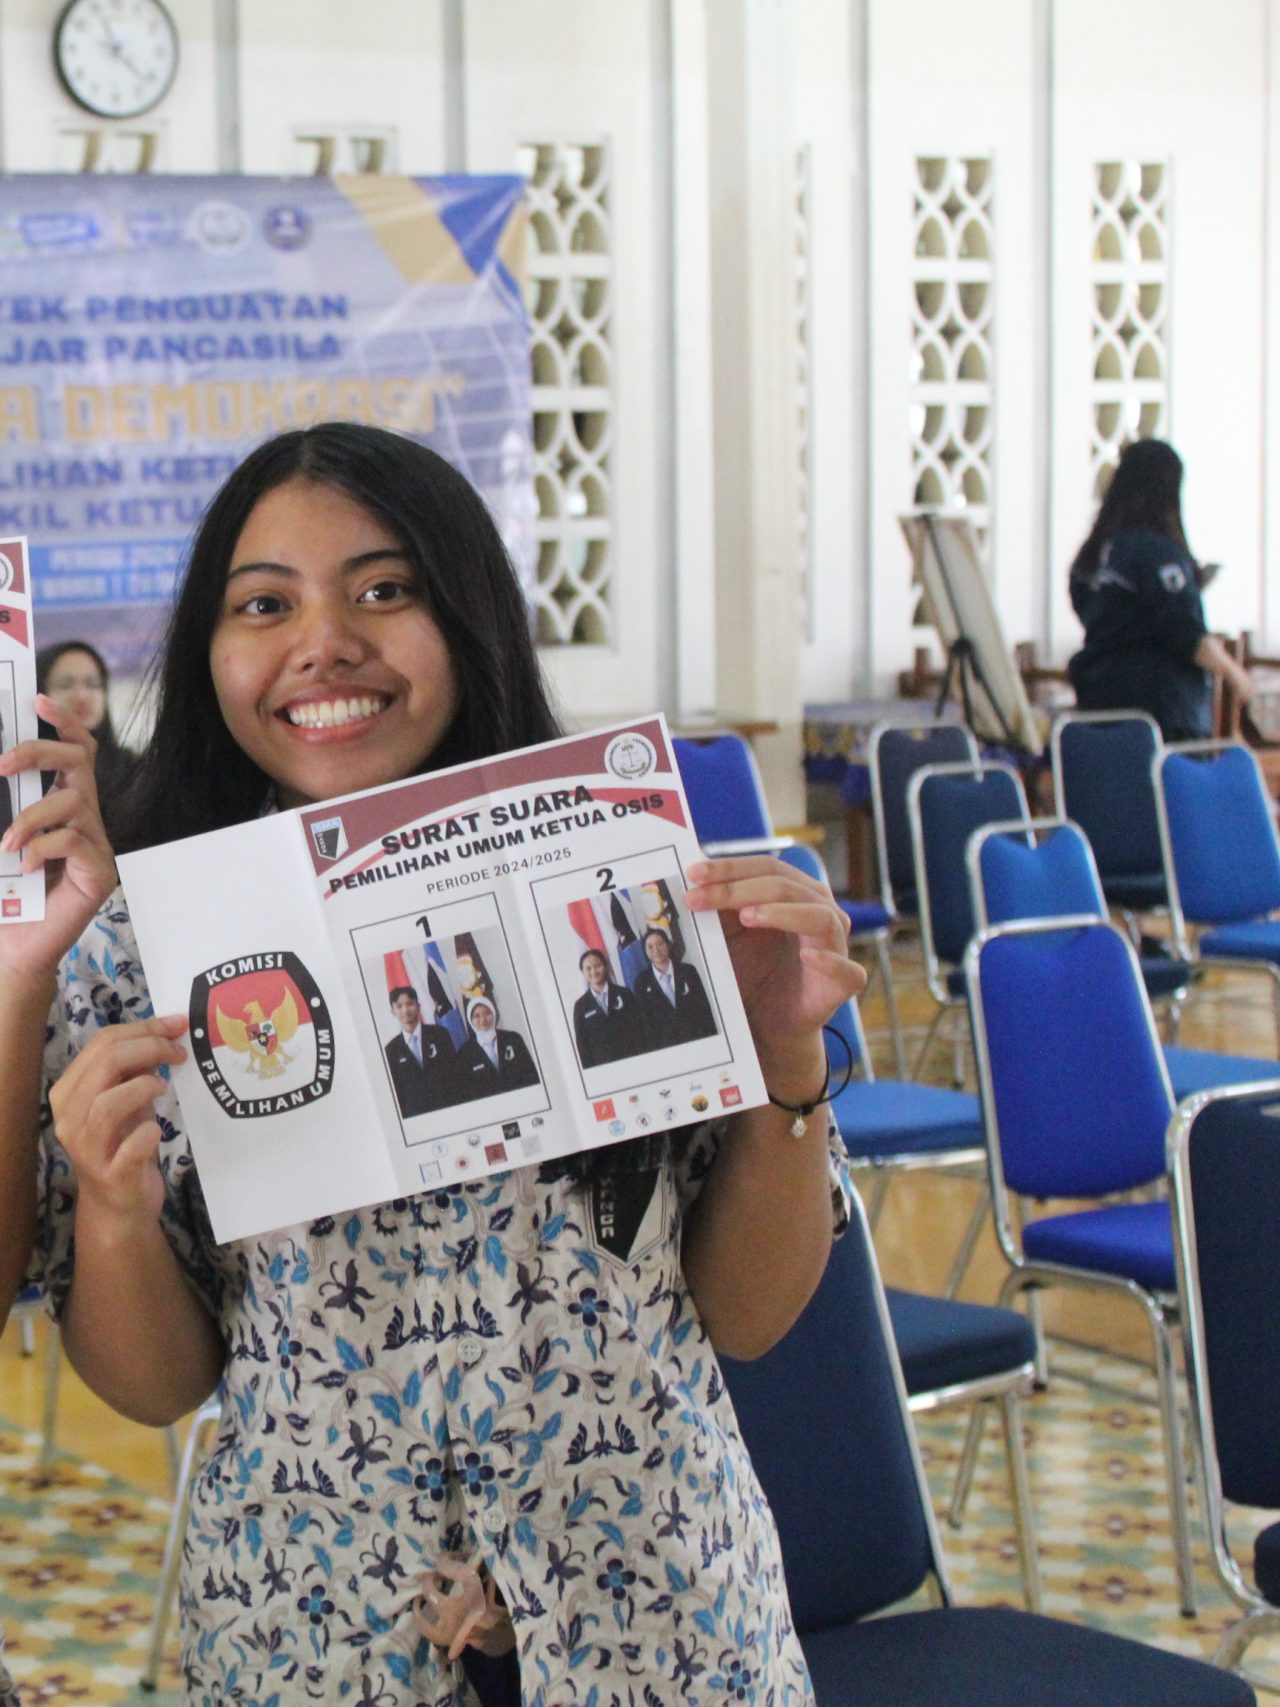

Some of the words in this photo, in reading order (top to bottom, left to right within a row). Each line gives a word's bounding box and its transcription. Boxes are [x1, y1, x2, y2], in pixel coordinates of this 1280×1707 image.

[86, 294, 348, 322] PENGUATAN
[105, 333, 341, 363] PANCASILA
[141, 452, 237, 484] KET
[85, 494, 202, 527] KETU
[381, 812, 481, 856] SURAT
[489, 784, 595, 827] SUARA
[329, 848, 451, 894] PEMILIHAN
[455, 829, 525, 859] UMUM
[530, 808, 607, 841] KETUA
[611, 793, 665, 819] OSIS
[426, 868, 490, 895] PERIODE
[493, 847, 572, 878] 2024/2025
[595, 867, 617, 892] 2
[415, 915, 432, 938] 1
[205, 953, 283, 986] KOMISI
[201, 1059, 306, 1116] PEMILIHAN
[308, 1028, 332, 1097] UMUM
